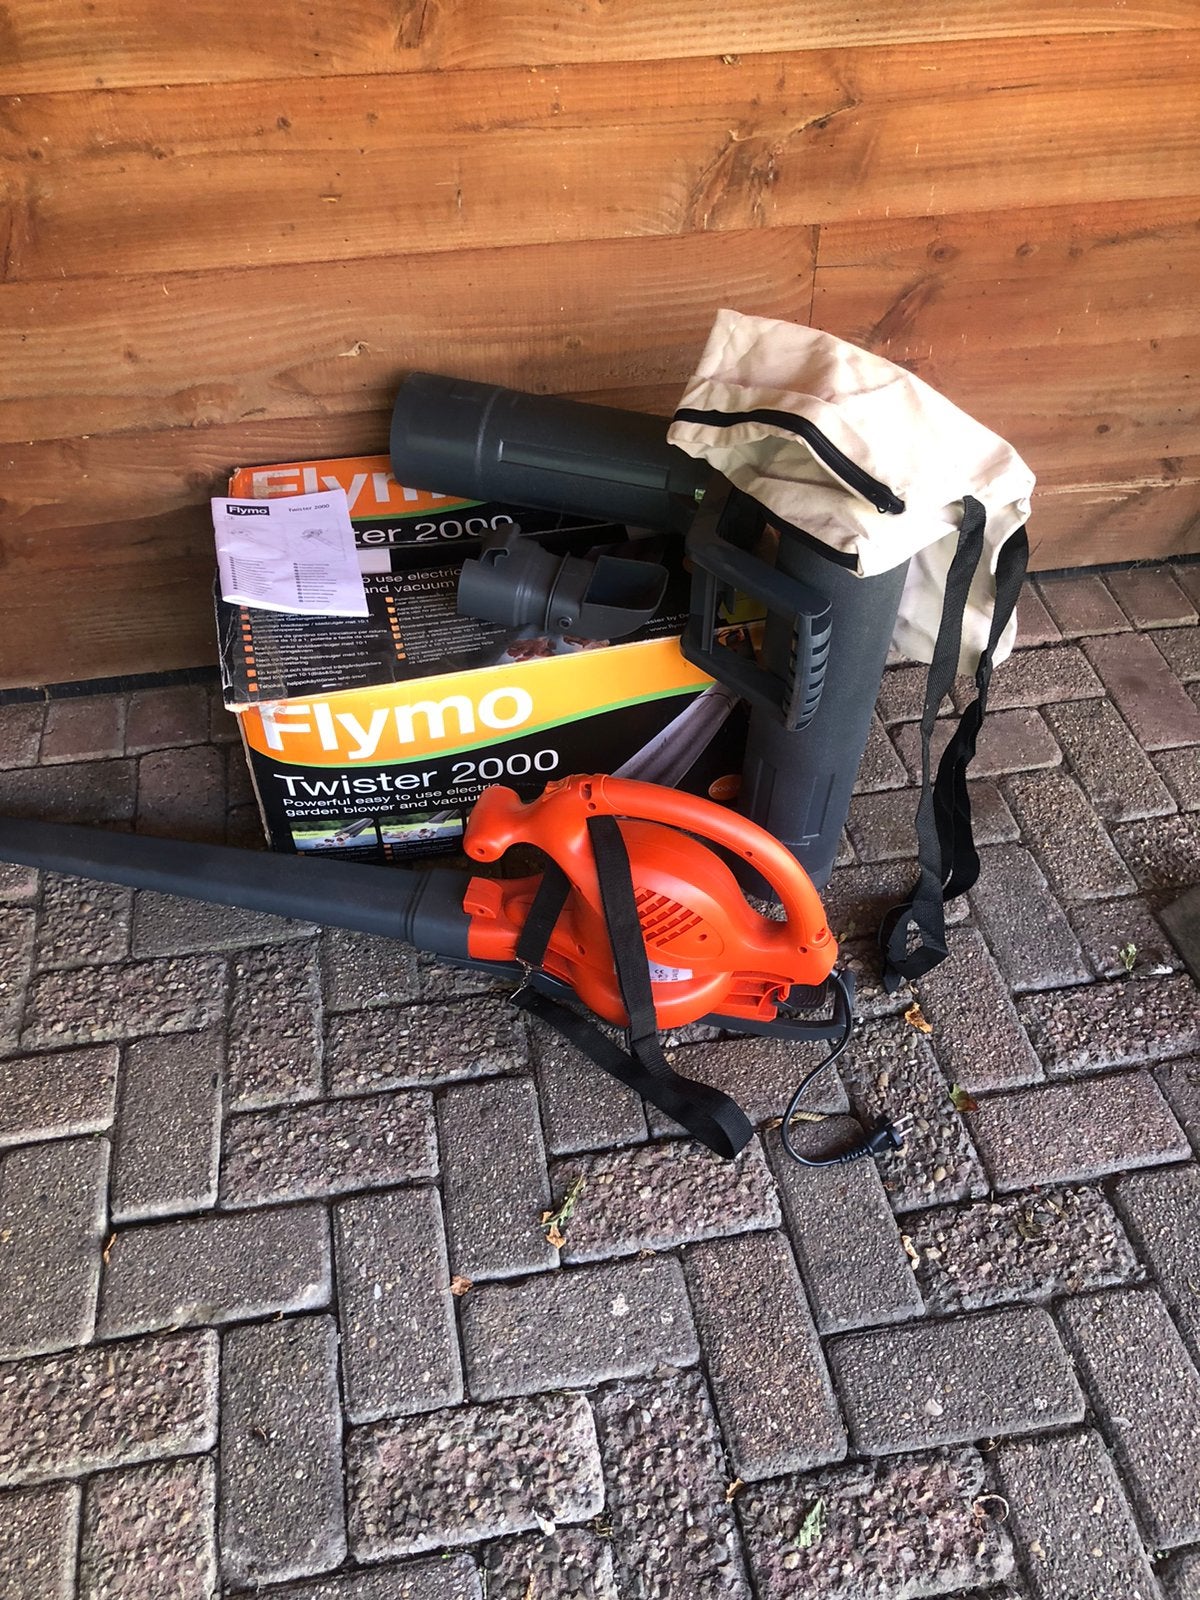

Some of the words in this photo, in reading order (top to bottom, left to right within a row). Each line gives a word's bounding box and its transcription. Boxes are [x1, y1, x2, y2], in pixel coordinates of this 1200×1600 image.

[228, 505, 269, 515] Flymo
[375, 576, 403, 584] use
[407, 568, 463, 581] electric
[393, 580, 455, 593] vacuum
[259, 686, 533, 760] Flymo
[273, 770, 438, 798] Twister
[451, 749, 560, 784] 2000
[282, 796, 351, 808] Powerful
[355, 795, 391, 806] easy
[395, 793, 411, 801] to
[415, 790, 443, 800] use
[285, 806, 340, 818] garden
[343, 803, 395, 815] blower
[399, 800, 429, 810] and
[432, 794, 480, 806] vacuu
